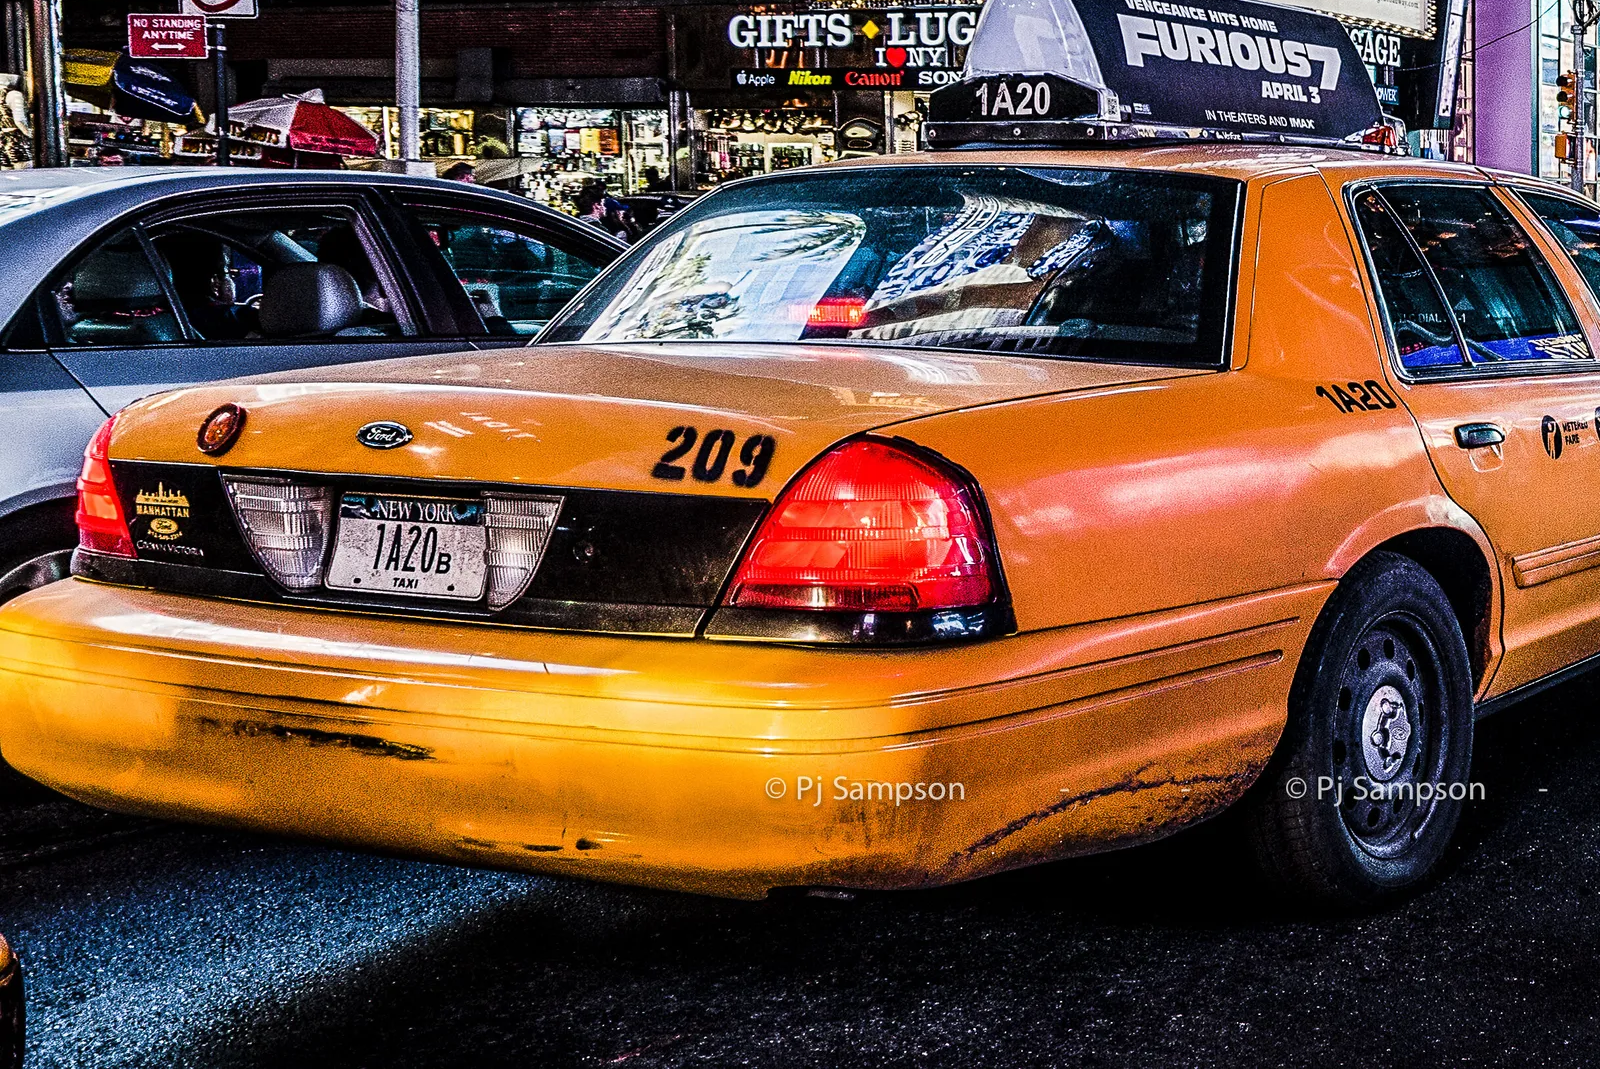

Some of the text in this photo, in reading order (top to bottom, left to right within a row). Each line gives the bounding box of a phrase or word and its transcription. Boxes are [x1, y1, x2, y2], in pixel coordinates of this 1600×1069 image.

[133, 19, 201, 29] NO STANDING
[1207, 6, 1243, 27] HITS
[1244, 13, 1278, 33] HOME
[142, 30, 194, 40] ANYTIME
[729, 13, 853, 48] GIFTS
[875, 47, 946, 67] I NY
[748, 70, 904, 88] Apple Nikon Canon
[974, 81, 1052, 118] 1A20
[1261, 81, 1321, 104] APRIL 3
[1205, 109, 1316, 130] IN THEATERS AND IMAX
[1315, 379, 1397, 414] 1A20
[365, 427, 398, 443] Ford
[1565, 434, 1581, 447] FARE
[651, 426, 778, 489] 209
[136, 504, 190, 518] MANHATTAN
[377, 500, 457, 523] NEW YORK
[136, 539, 167, 552] CROWN
[392, 576, 420, 590] TAXI
